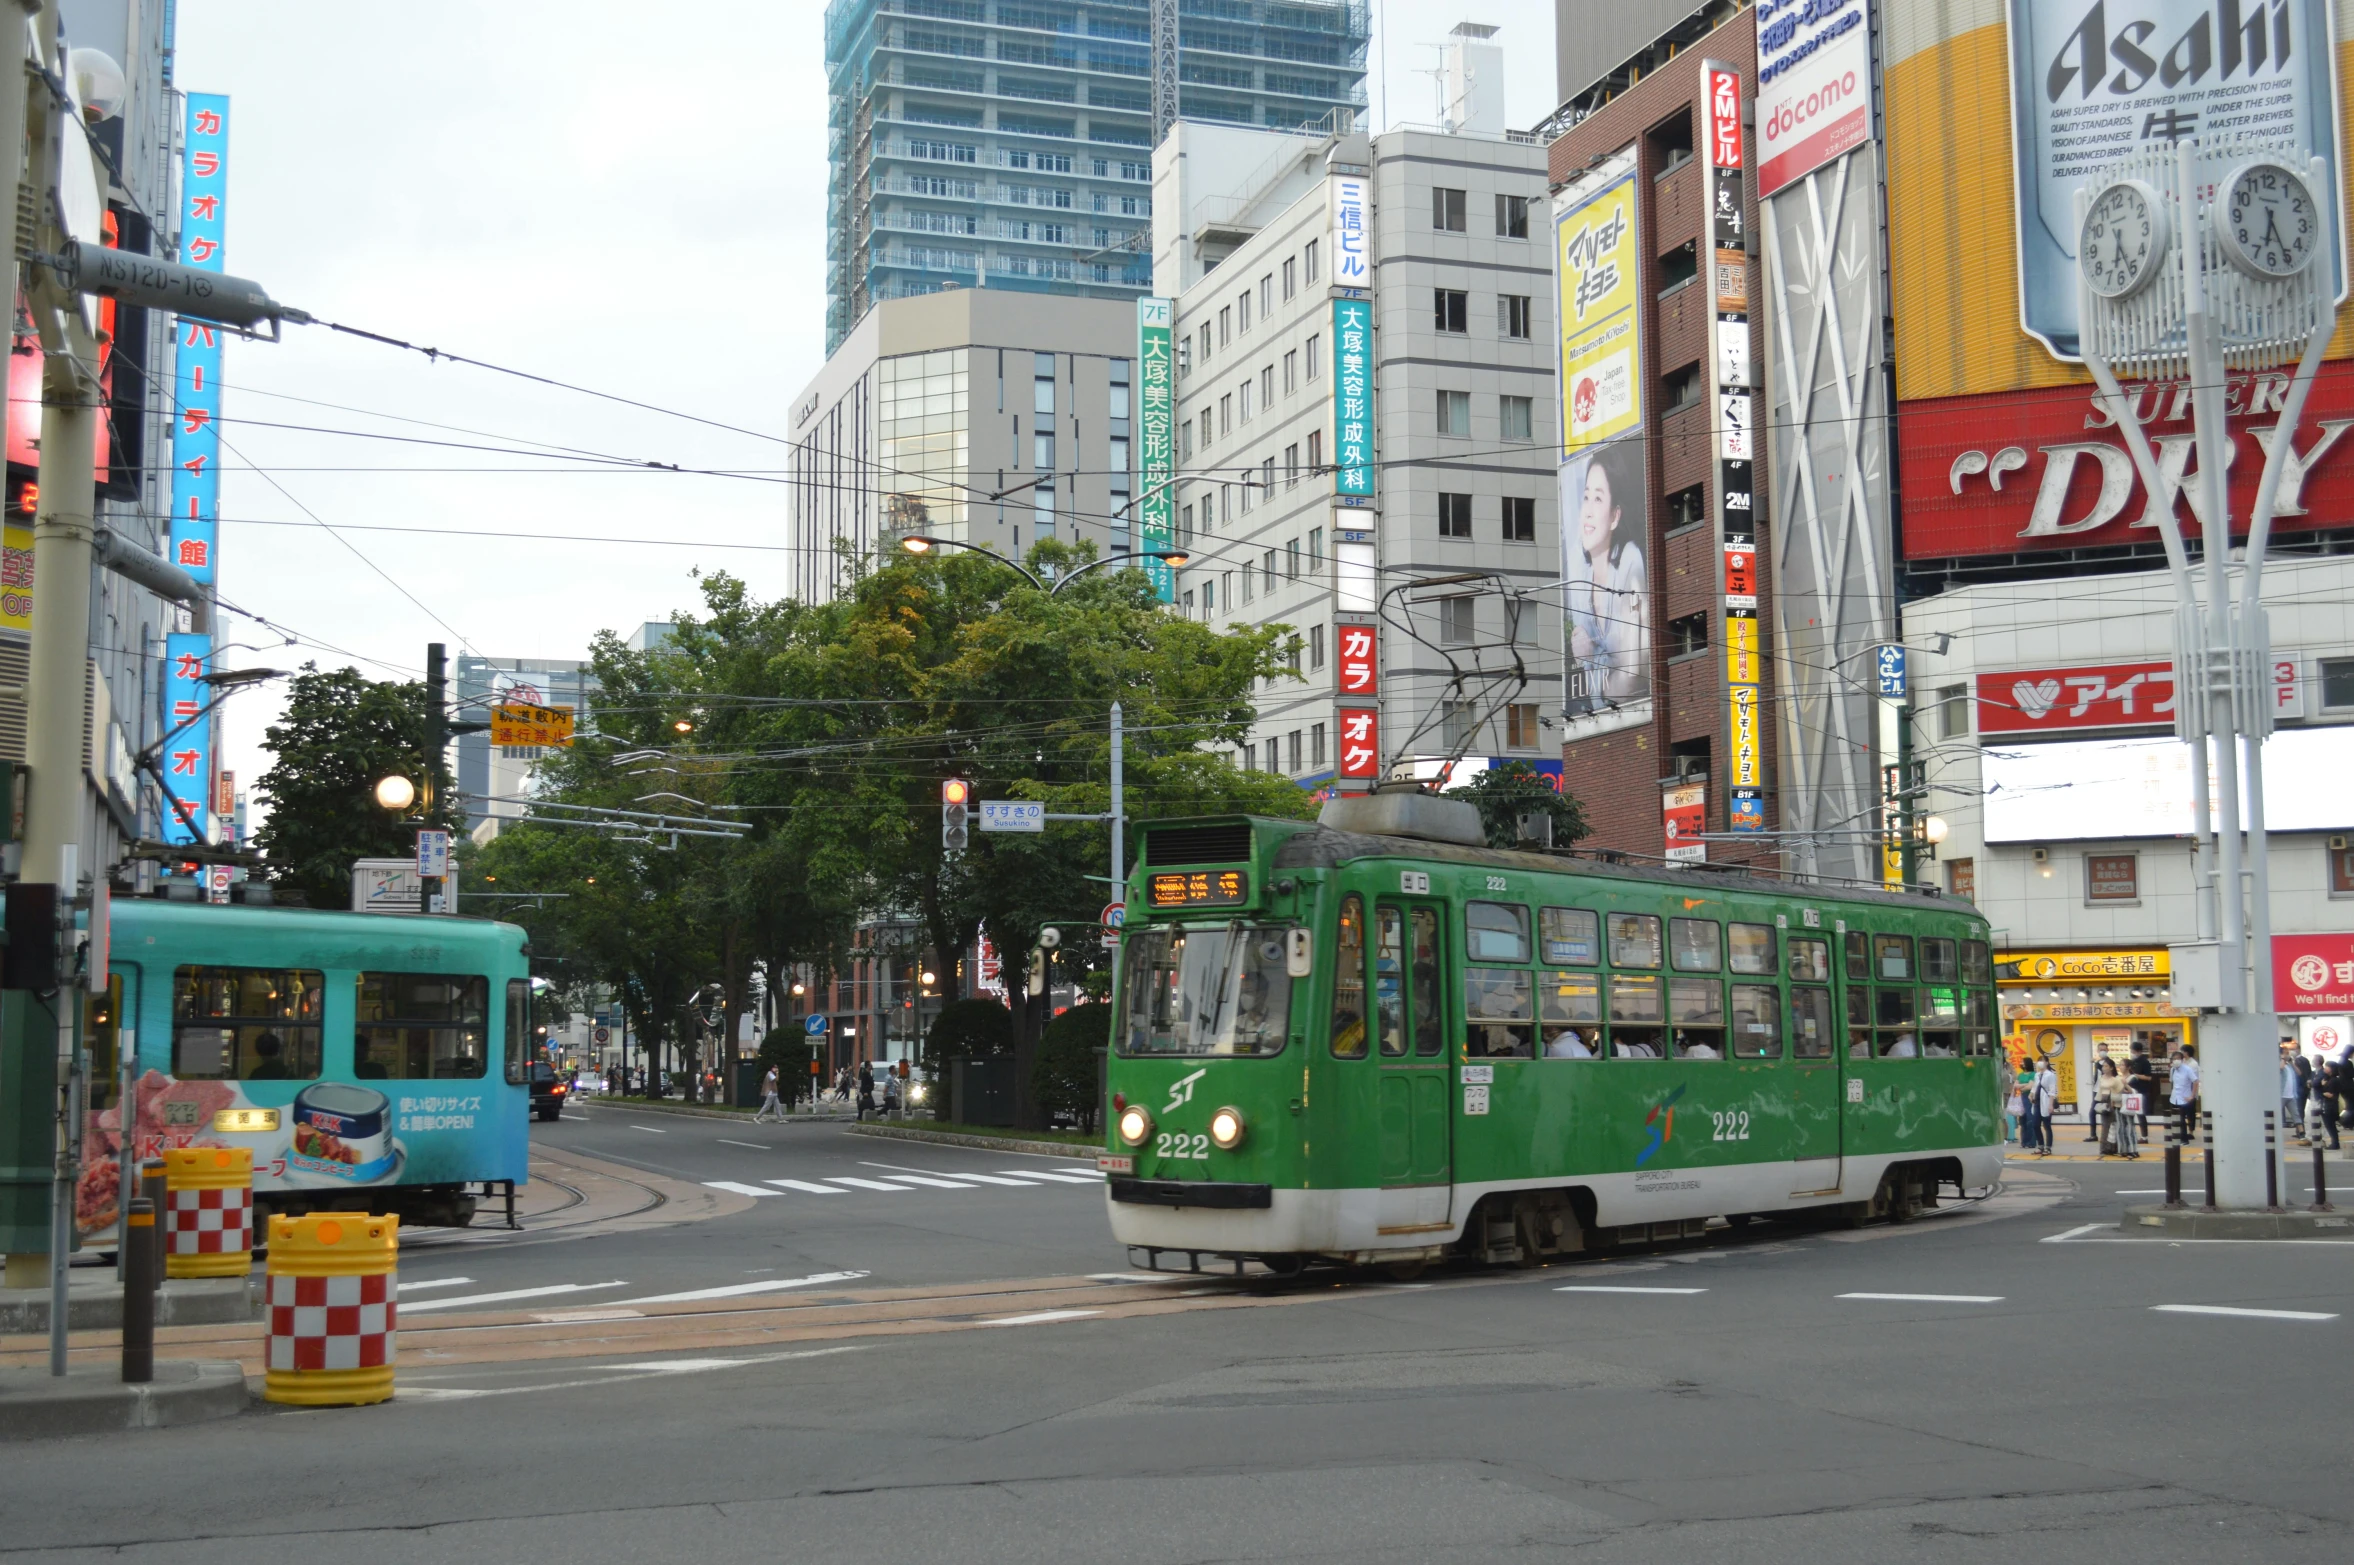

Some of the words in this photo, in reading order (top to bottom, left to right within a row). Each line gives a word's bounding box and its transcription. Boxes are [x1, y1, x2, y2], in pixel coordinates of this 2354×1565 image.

[2046, 0, 2291, 104] Asahi
[1780, 96, 1792, 110] NTT
[2050, 108, 2072, 119] ASAHI
[2073, 105, 2100, 116] SUPER
[2102, 102, 2120, 113] DRY
[2123, 101, 2131, 111] IS
[2134, 95, 2176, 110] BREWED
[2178, 91, 2204, 104] WITH
[2207, 84, 2257, 100] PRECISION
[2260, 82, 2272, 92] TO
[2272, 78, 2293, 90] HIGH
[1766, 71, 1856, 142] docomo
[2206, 101, 2242, 115] UNDER
[2244, 98, 2263, 109] THE
[1715, 74, 1739, 167] 2Mビル
[2050, 122, 2080, 134] QUALITY
[2080, 116, 2134, 130] STANDARDS,
[2206, 116, 2250, 130] MASTER
[1830, 115, 1864, 143] ドコモショップ
[2051, 138, 2075, 148] VISION
[2076, 136, 2087, 146] OF
[2087, 131, 2132, 144] JAPANESE
[2052, 154, 2066, 164] OUR
[2066, 150, 2107, 162] ADVANCED
[1722, 169, 1733, 178] 8F
[2052, 168, 2082, 178] DELIVER
[190, 109, 222, 262] カラオケ
[2246, 178, 2258, 193] 11
[2260, 174, 2276, 190] 12
[2282, 184, 2289, 198] 1
[2110, 193, 2123, 208] 12
[2128, 196, 2134, 209] 1
[2234, 191, 2250, 207] 10
[2292, 198, 2302, 213] 2
[2099, 206, 2110, 221] 11
[2136, 204, 2144, 218] 2
[2232, 208, 2242, 224] 9
[1340, 183, 1365, 277] 三信ビル
[2091, 224, 2104, 240] 10
[2141, 222, 2149, 236] 3
[2298, 219, 2308, 233] 3
[1568, 207, 1626, 268] マツモト
[2238, 229, 2248, 244] 8
[1724, 240, 1736, 250] 7F
[2090, 244, 2098, 258] 9
[2137, 242, 2146, 257] 4
[2252, 244, 2262, 260] 7
[2292, 238, 2302, 252] 4
[2267, 252, 2276, 266] 6
[2095, 261, 2102, 276] 8
[2106, 271, 2114, 285] 7
[2117, 270, 2125, 286] 6
[1342, 288, 1362, 298] 7F
[1576, 263, 1619, 318] キヨシ
[1144, 305, 1167, 320] 7F
[1726, 314, 1738, 322] 6F
[1569, 335, 1605, 361] Matsumoto
[1602, 378, 1625, 396] Tax-free
[1728, 387, 1740, 396] 5F
[1342, 307, 1366, 490] 大塚美容形成外科
[1610, 393, 1626, 406] Shop
[1144, 335, 1170, 535] 大塚美容形成外科
[1730, 460, 1742, 469] 4F
[1345, 496, 1366, 506] 5F
[1726, 492, 1750, 510] 2M
[1345, 532, 1366, 541] 5F
[1732, 534, 1744, 544] 3F
[1572, 668, 1610, 700] ELIXIR
[498, 728, 567, 744] 通行禁止
[1737, 790, 1754, 798] B1F
[985, 805, 1040, 818] すすきの
[994, 819, 1030, 827] Susukino
[420, 833, 431, 875] 駐車禁止
[1404, 874, 1427, 891] 出口
[1486, 876, 1507, 891] 222
[1804, 911, 1820, 925] 入口
[2062, 956, 2155, 974] CoCo壱番屋
[2294, 994, 2322, 1004] We'll
[2326, 994, 2347, 1004] find
[1466, 1088, 1487, 1098] ワンマン
[166, 1104, 196, 1112] ワンマン
[400, 1096, 482, 1114] 使い切りサイズ
[1470, 1102, 1484, 1112] 出口
[170, 1114, 194, 1123] 入口
[312, 1112, 342, 1133] K&K
[1712, 1110, 1750, 1140] 222
[1156, 1132, 1210, 1160] 222
[1636, 1171, 1660, 1181] SAPPORO
[1661, 1170, 1673, 1179] CITY
[1635, 1182, 1680, 1193] TRANSPORTATION
[1680, 1180, 1702, 1190] BUREAU
